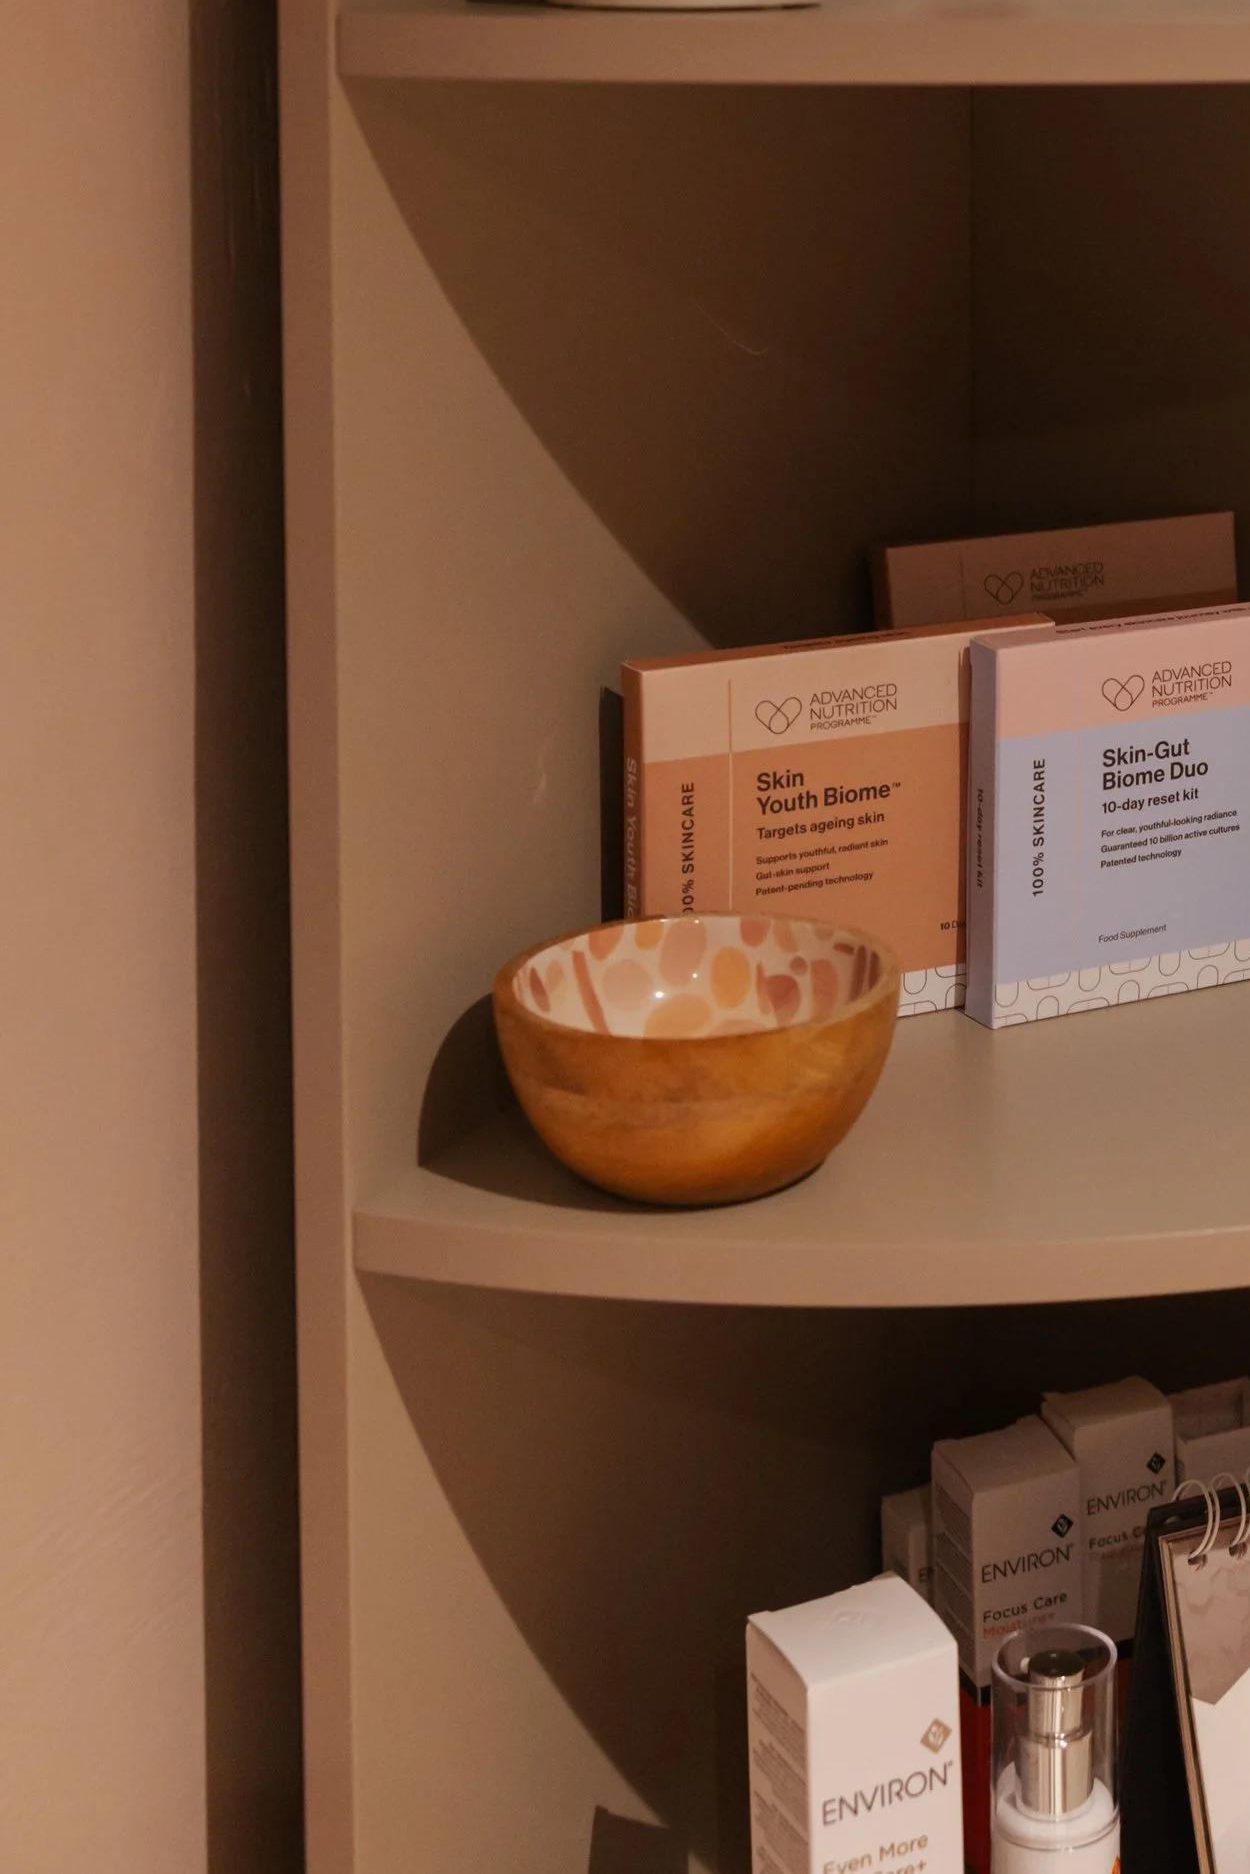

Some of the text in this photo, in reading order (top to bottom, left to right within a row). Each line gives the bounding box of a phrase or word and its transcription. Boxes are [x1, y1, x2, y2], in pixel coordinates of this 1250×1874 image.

[1030, 561, 1104, 579] ADVANCED
[1030, 574, 1104, 592] NUTRITION
[1152, 661, 1232, 683] ADVANCED
[809, 683, 897, 706] ADVANCED
[1152, 675, 1232, 698] NUTRITION
[809, 697, 897, 721] NUTRITION
[1102, 738, 1190, 768] Skin-Gut
[627, 757, 638, 808] Skin
[756, 769, 804, 792] Skin
[1102, 762, 1209, 791] Biome Duo
[756, 790, 818, 816] Youth
[1102, 788, 1199, 814] 10-day reset kit
[682, 782, 695, 874] SKINCARE
[756, 811, 885, 840] Targets ageing skin
[1032, 758, 1045, 897] 100% SKINCARE
[1101, 810, 1237, 838] For clear, youthful-looking radiance
[627, 815, 637, 880] Youth
[756, 837, 888, 865] Supports youthful, radiant skin
[1100, 824, 1241, 853] Guaranteed 10 billion active cultures
[755, 862, 830, 881] Gut-skin support
[1100, 848, 1183, 869] Patented technology
[755, 871, 873, 896] Patent-pending technology
[1098, 924, 1167, 944] Food Supplement
[1088, 1530, 1129, 1550] Focus
[983, 1592, 1068, 1624] Focus Care
[822, 1833, 929, 1874] Even More
